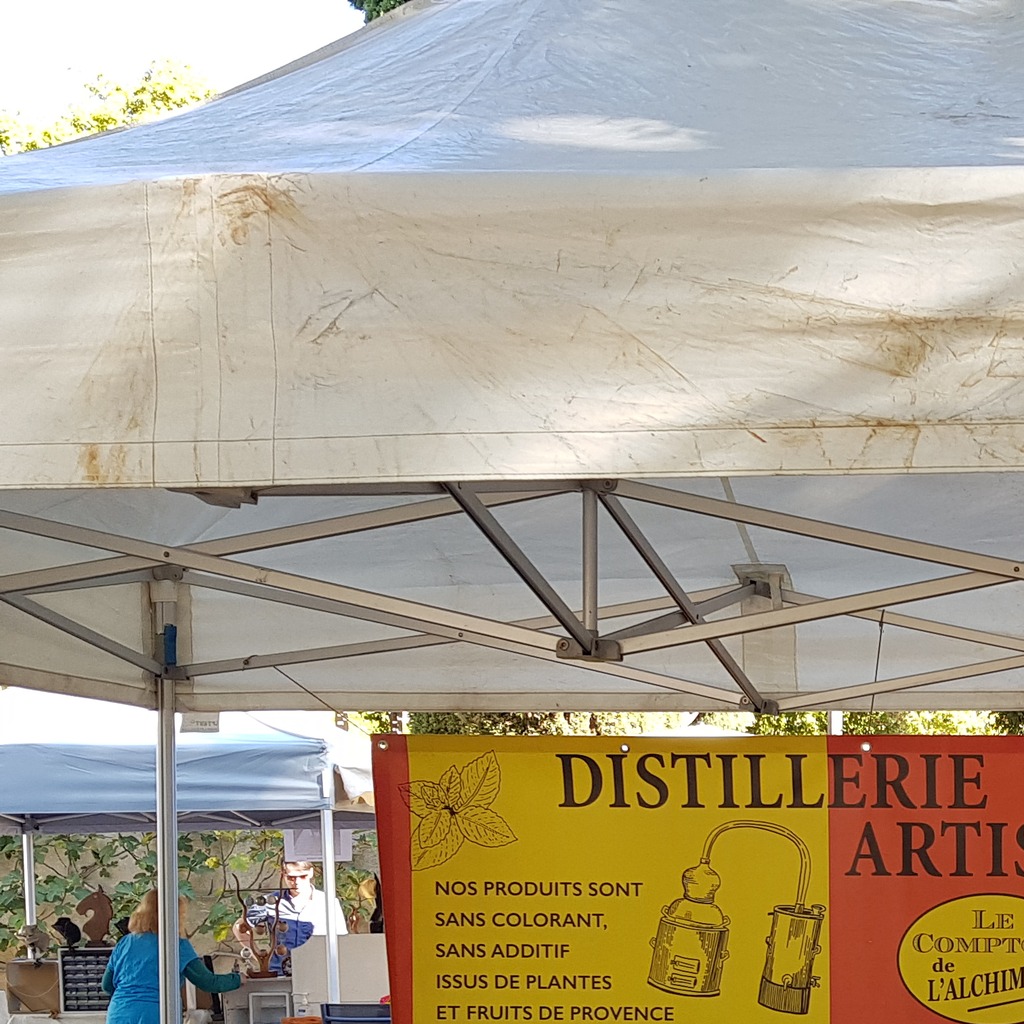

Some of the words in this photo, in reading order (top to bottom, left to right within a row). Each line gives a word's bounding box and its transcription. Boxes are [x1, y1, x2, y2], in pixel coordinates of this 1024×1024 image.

[556, 753, 988, 809] DISTILLERIE
[435, 881, 478, 897] NOS
[484, 881, 584, 897] PRODUITS
[588, 882, 643, 897] SONT
[435, 912, 486, 928] SANS
[492, 912, 608, 931] COLORANT,
[971, 909, 1014, 930] LE
[435, 943, 486, 959] SANS
[491, 943, 570, 959] ADDITIF
[932, 957, 955, 974] de
[436, 974, 488, 990] ISSUS
[494, 975, 520, 990] DE
[526, 975, 612, 990] PLANTES
[436, 1005, 459, 1021] ET
[466, 1005, 532, 1021] FRUITS
[539, 1006, 564, 1021] DE
[571, 1006, 675, 1022] PROVENCE
